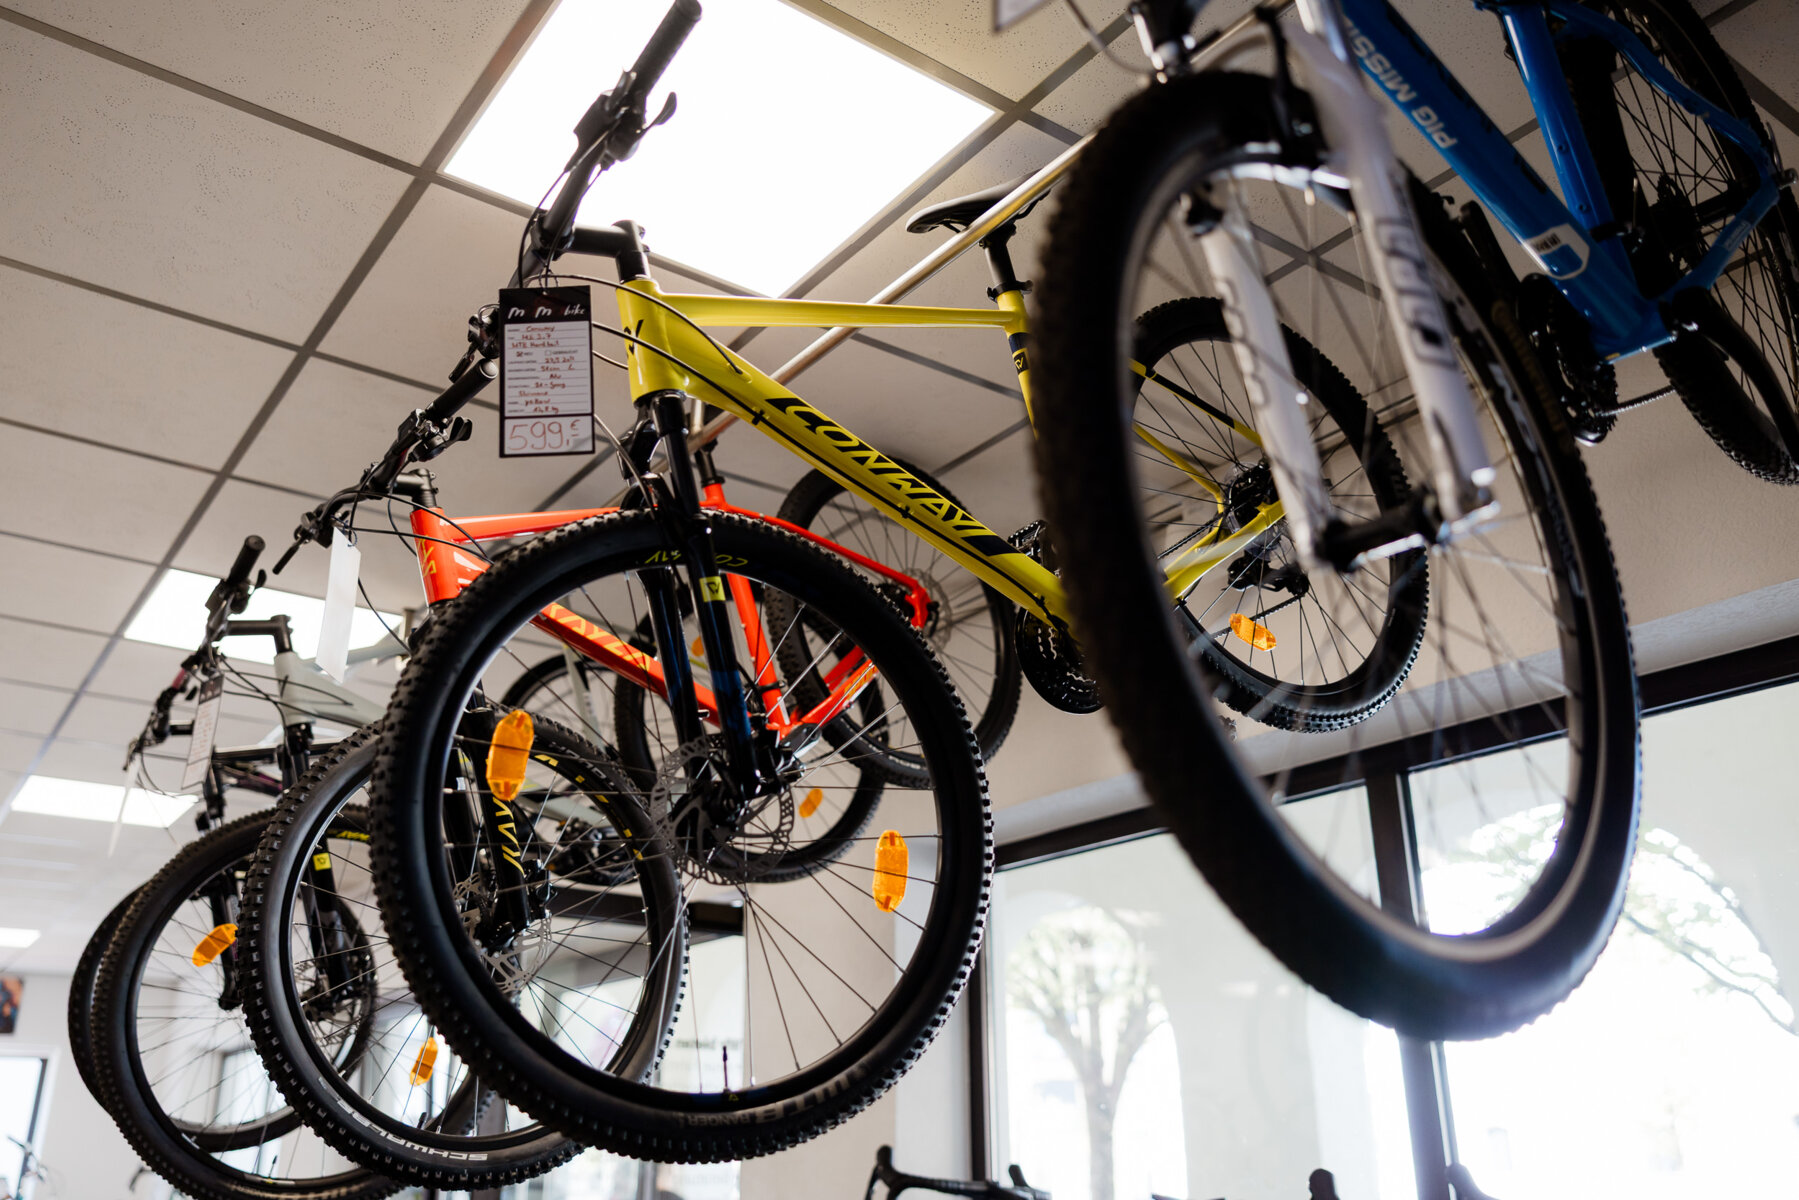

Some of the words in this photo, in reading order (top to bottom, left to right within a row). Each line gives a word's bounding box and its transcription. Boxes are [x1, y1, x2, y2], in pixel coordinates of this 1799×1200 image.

[1411, 105, 1458, 150] PIG
[785, 405, 987, 530] CONWAY
[337, 1100, 489, 1161] SCHWALBE
[687, 1110, 751, 1127] RANGER
